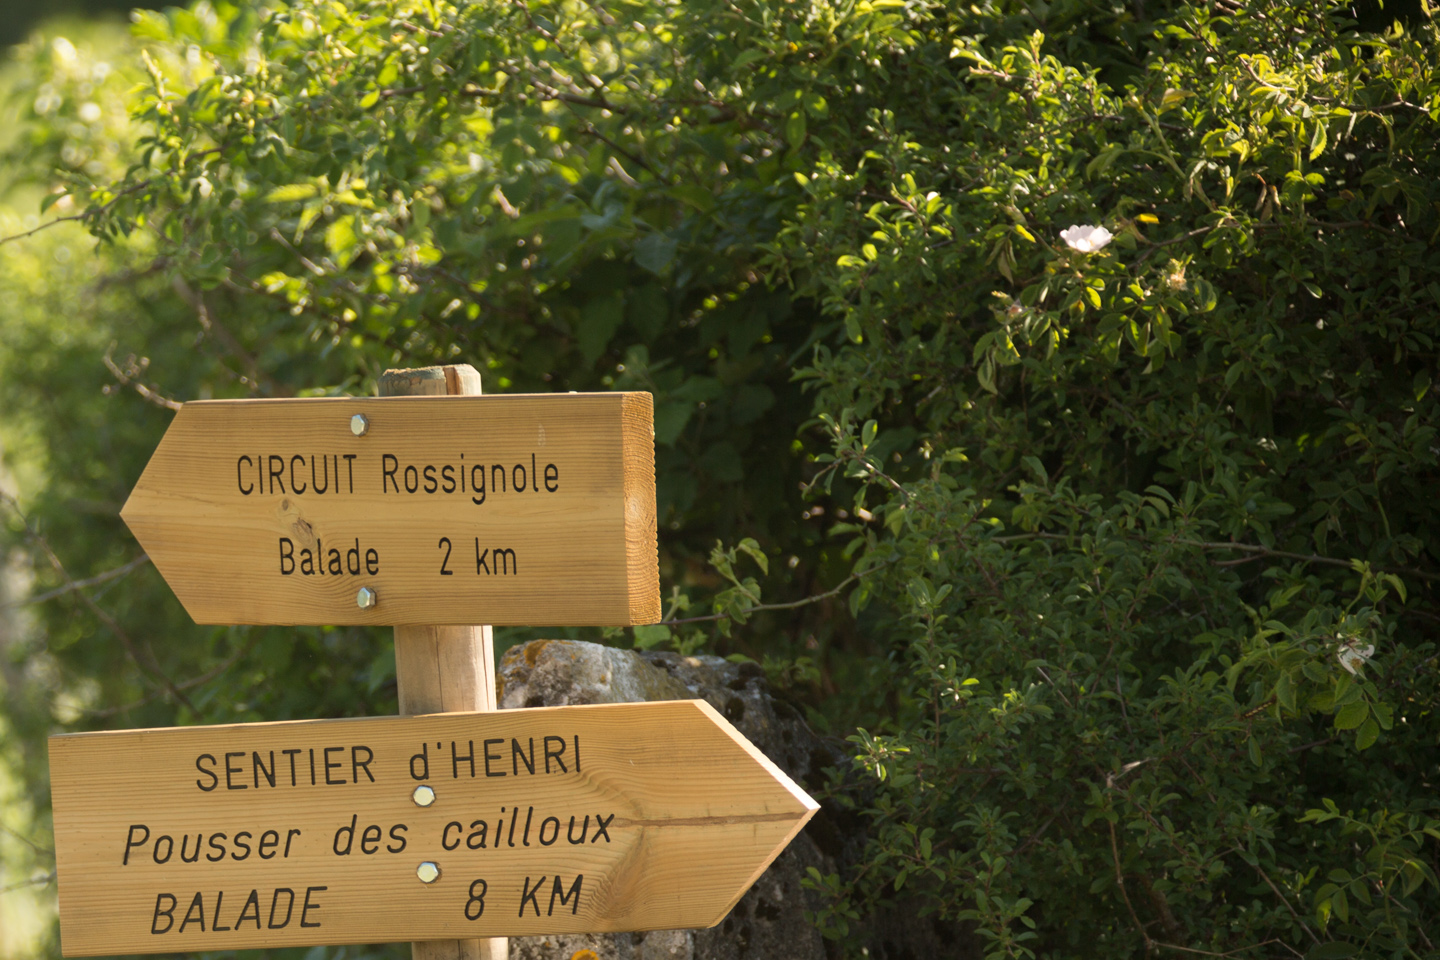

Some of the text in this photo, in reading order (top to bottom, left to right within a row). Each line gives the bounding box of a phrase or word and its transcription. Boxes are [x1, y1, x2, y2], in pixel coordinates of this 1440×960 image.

[237, 452, 560, 506] CIRCUIT Rossignole
[278, 536, 518, 577] Balade 2 km
[195, 734, 582, 793] SENTIER d'HENRI
[122, 805, 616, 866] Pousser des cailloux
[150, 873, 584, 935] BALADE 8 KM
